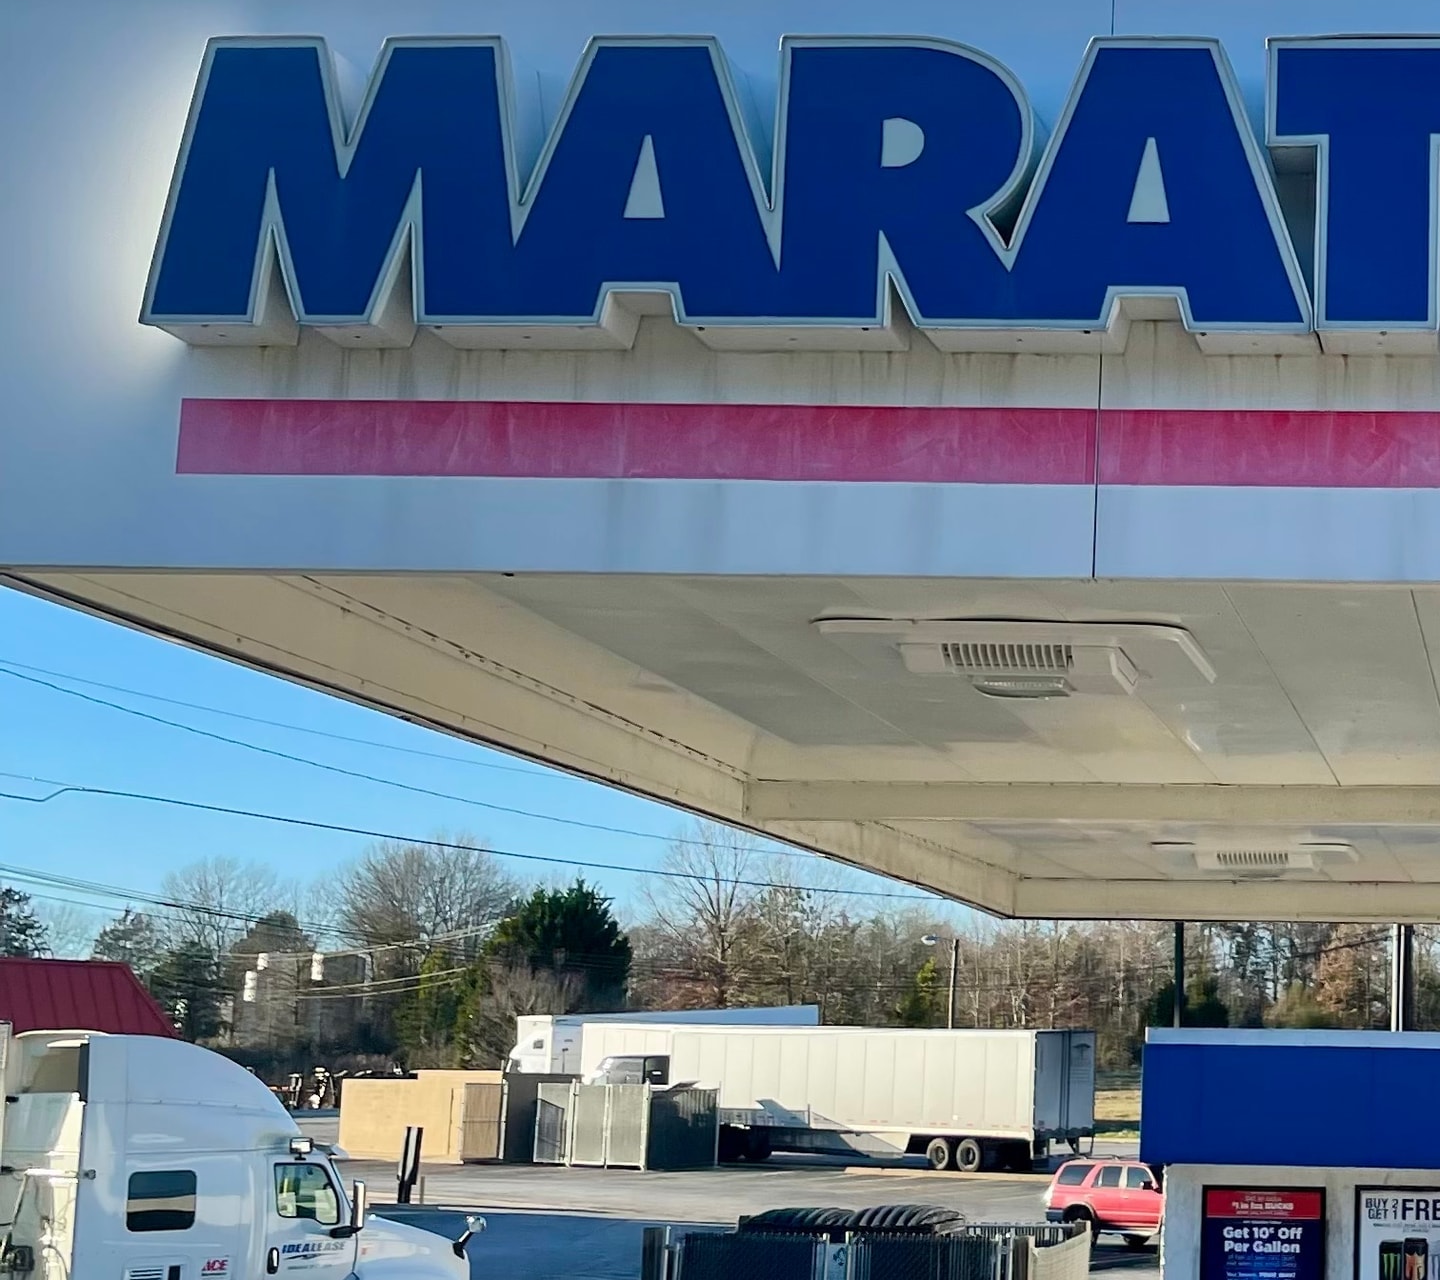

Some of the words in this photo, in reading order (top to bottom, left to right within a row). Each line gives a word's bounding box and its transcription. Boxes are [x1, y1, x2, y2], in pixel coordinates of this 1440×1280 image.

[1365, 1198, 1388, 1208] BUY
[1392, 1199, 1399, 1209] 2
[1368, 1209, 1388, 1219] GET
[1223, 1227, 1250, 1239] Get
[1278, 1227, 1303, 1240] Off
[281, 1241, 345, 1254] IDEALEASE
[1224, 1240, 1249, 1252] Per
[1253, 1241, 1301, 1253] Gallon
[201, 1259, 229, 1271] ACE
